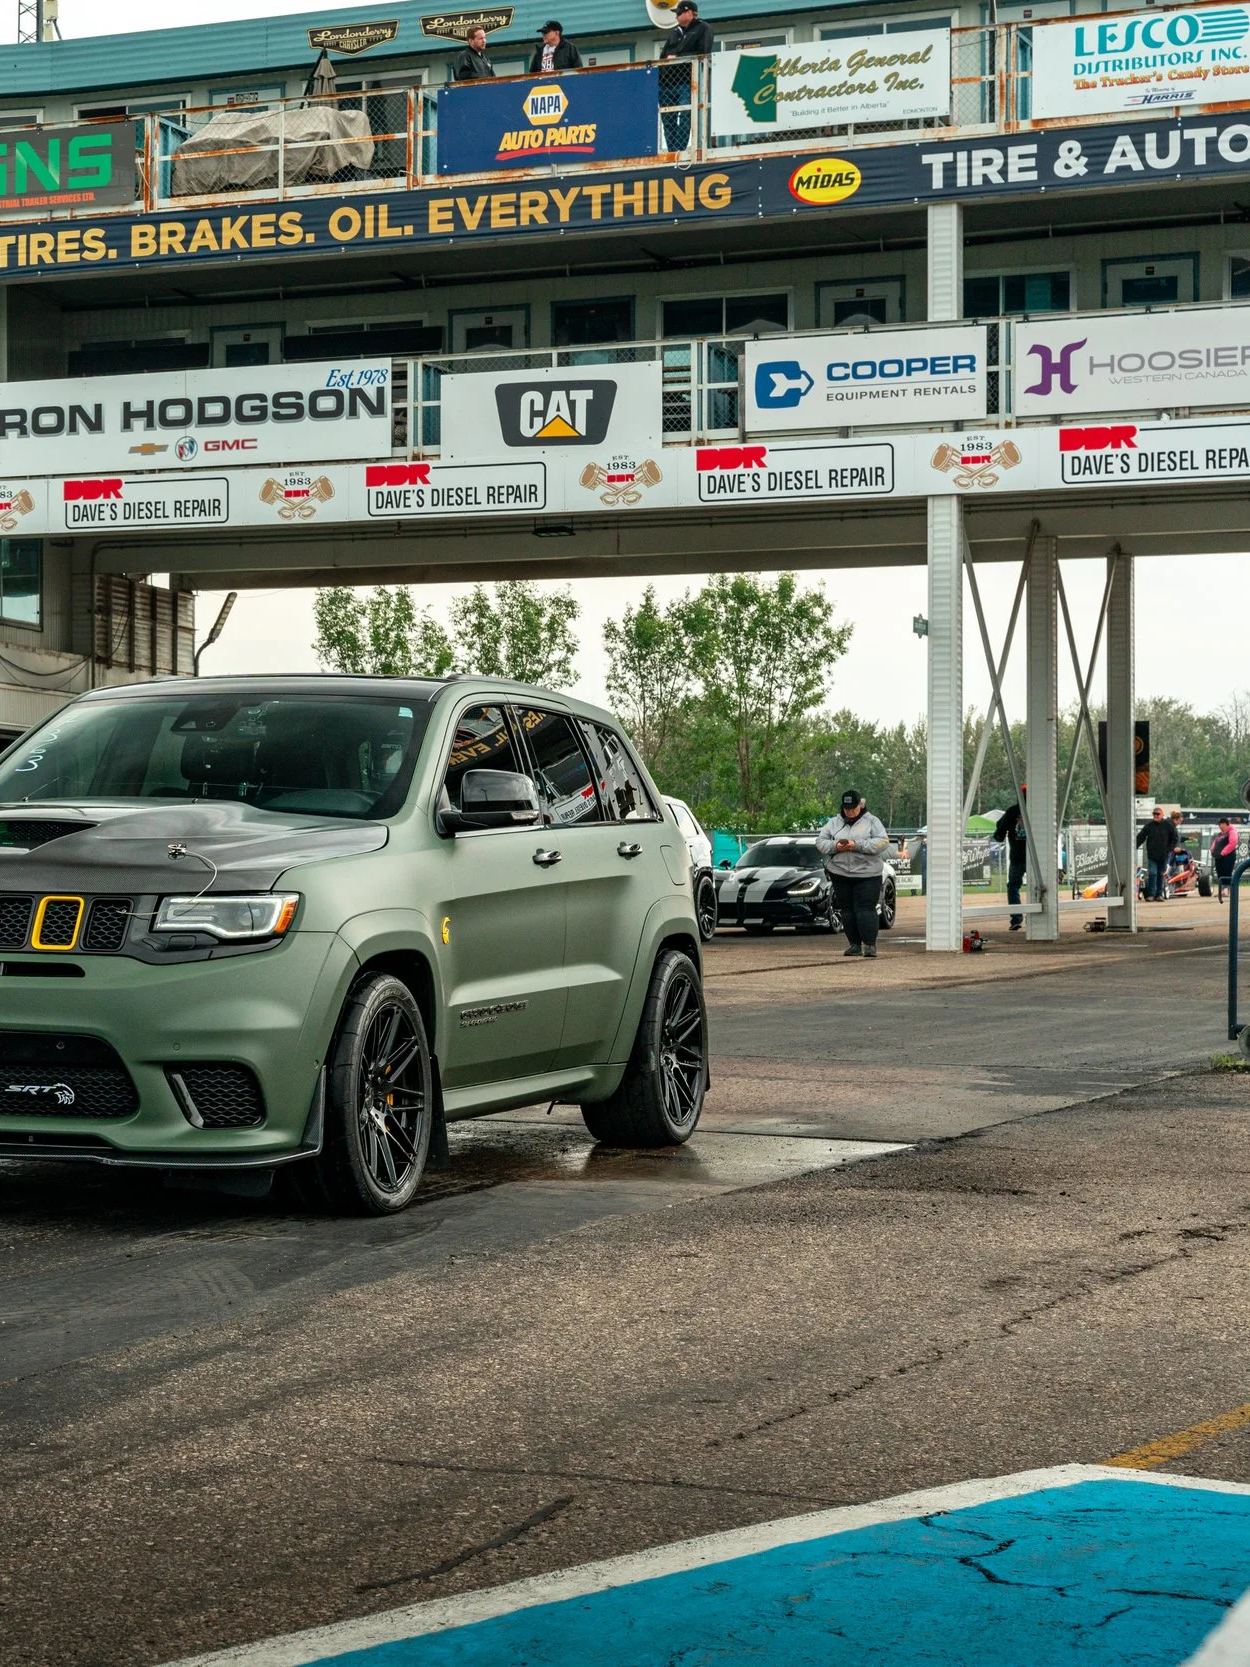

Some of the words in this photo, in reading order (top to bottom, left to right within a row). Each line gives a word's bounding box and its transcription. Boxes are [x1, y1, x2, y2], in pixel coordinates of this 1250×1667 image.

[423, 14, 508, 29] Londonderry
[314, 26, 393, 42] Londonderry
[1074, 14, 1200, 57] LESCO
[760, 55, 842, 80] Alberta
[846, 44, 934, 77] General
[1073, 50, 1204, 76] DISTRIBUTORS
[1211, 46, 1247, 62] INC.
[753, 78, 879, 105] Contractors
[883, 71, 925, 91] Inc.
[1073, 78, 1097, 90] The
[1167, 65, 1210, 82] Candy
[530, 95, 561, 115] NAPA
[820, 107, 826, 115] it
[826, 104, 850, 113] Better
[851, 103, 858, 111] in
[1142, 92, 1194, 104] HARRIS
[902, 106, 938, 115] EDMONTON
[499, 128, 543, 151] AUTO
[545, 123, 597, 147] PARTS
[922, 143, 1039, 190] TIRE
[1053, 140, 1089, 178] &
[1103, 123, 1250, 174] AUTO
[21, 196, 48, 207] TRAILER
[49, 193, 82, 205] SERVICES
[82, 191, 96, 202] LTD.
[130, 212, 315, 259] BRAKES.
[328, 205, 414, 240] OIL.
[428, 172, 732, 234] EVERYTHING
[325, 369, 356, 388] Est.
[356, 368, 388, 386] 1978
[826, 354, 977, 382] COOPER
[1108, 372, 1182, 385] WESTERN
[1184, 369, 1248, 381] CANADA
[826, 387, 908, 402] EQUIPMENT
[913, 384, 977, 397] RENTALS
[120, 386, 388, 433] HODGSON
[519, 389, 593, 438] CAT
[203, 438, 258, 453] GMC
[960, 440, 993, 452] 1983
[1059, 425, 1138, 451] DDR
[605, 460, 637, 471] 1983
[696, 446, 768, 471] DDR
[1070, 452, 1131, 475] DAVE'S
[1137, 449, 1200, 472] DIESEL
[1204, 446, 1250, 469] REPA
[283, 475, 311, 487] 1983
[365, 464, 431, 487] DDR
[706, 472, 761, 494] DAVE'S
[767, 469, 824, 491] DIESEL
[828, 466, 886, 488] REPAIR
[64, 478, 124, 502] DDR
[375, 487, 426, 509] DAVE'S
[430, 486, 482, 507] DIESEL
[487, 484, 538, 504] REPAIR
[72, 502, 118, 522] DAVE'S
[123, 499, 175, 520] DIESEL
[178, 498, 222, 519] REPAIR
[4, 1084, 56, 1096] SRT
